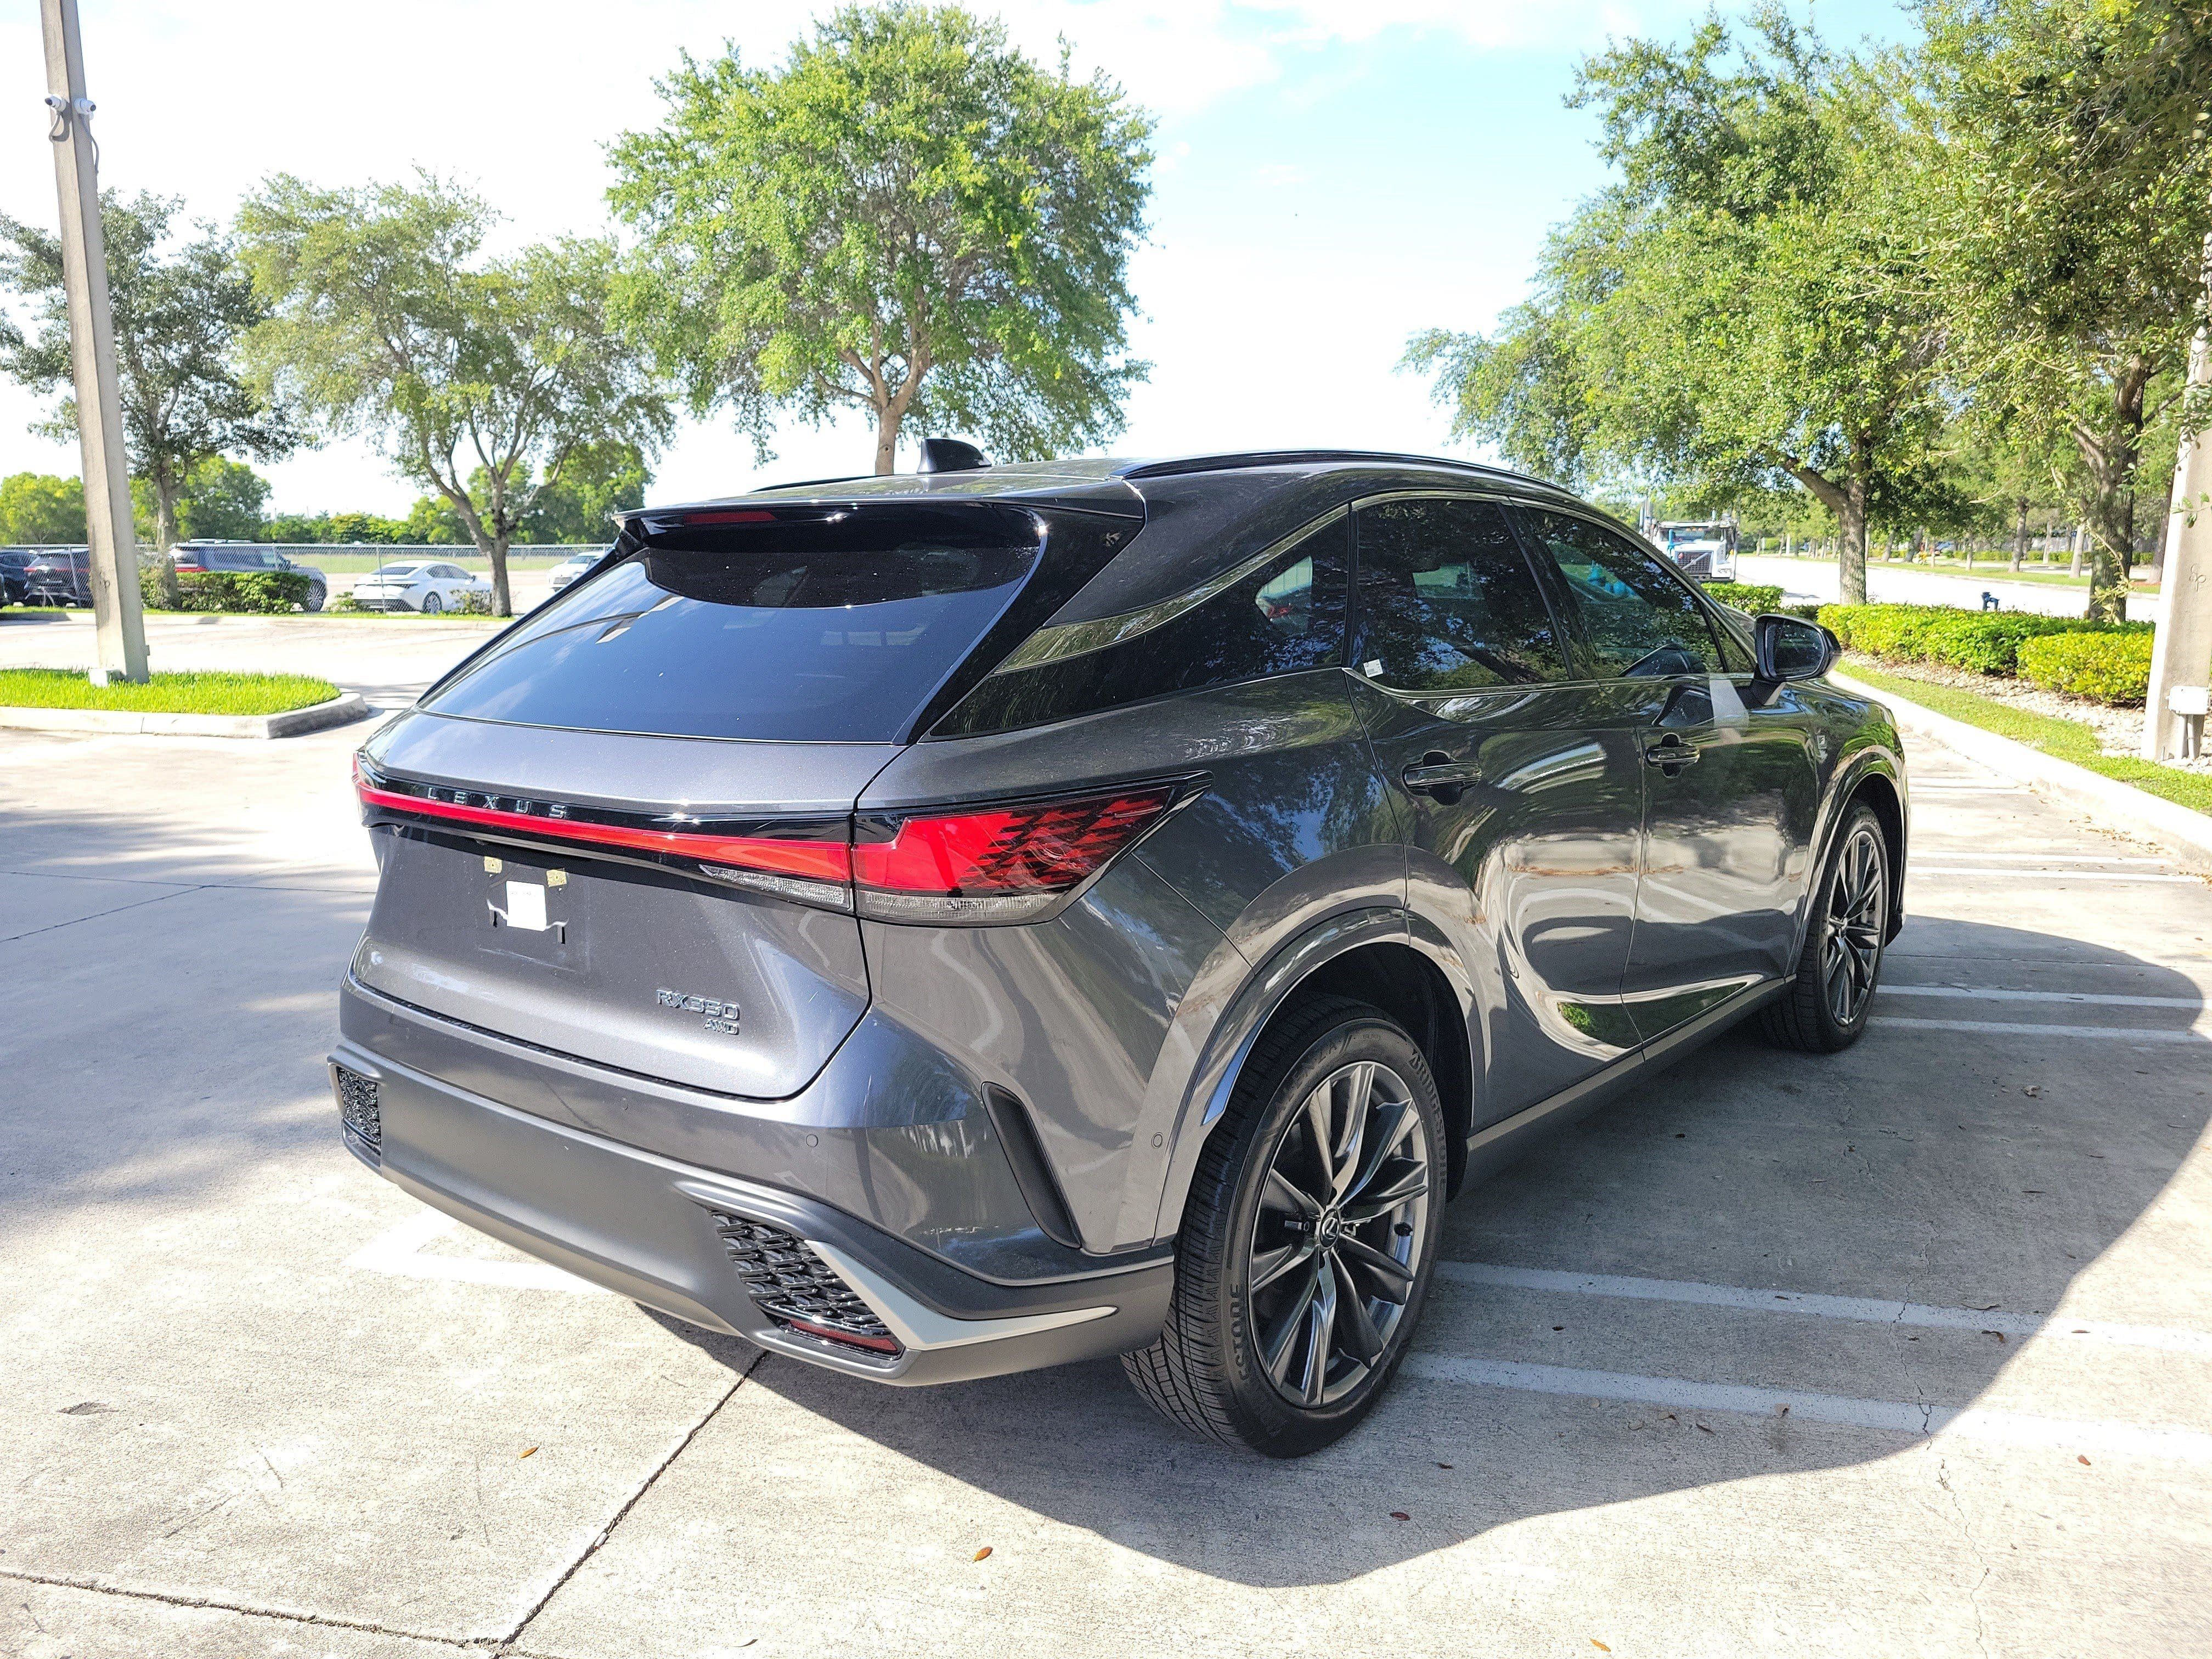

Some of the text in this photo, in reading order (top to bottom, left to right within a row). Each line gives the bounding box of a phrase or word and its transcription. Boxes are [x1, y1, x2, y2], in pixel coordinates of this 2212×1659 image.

[427, 787, 567, 820] LEXUS
[656, 989, 740, 1020] RX350
[703, 1018, 740, 1036] AWD
